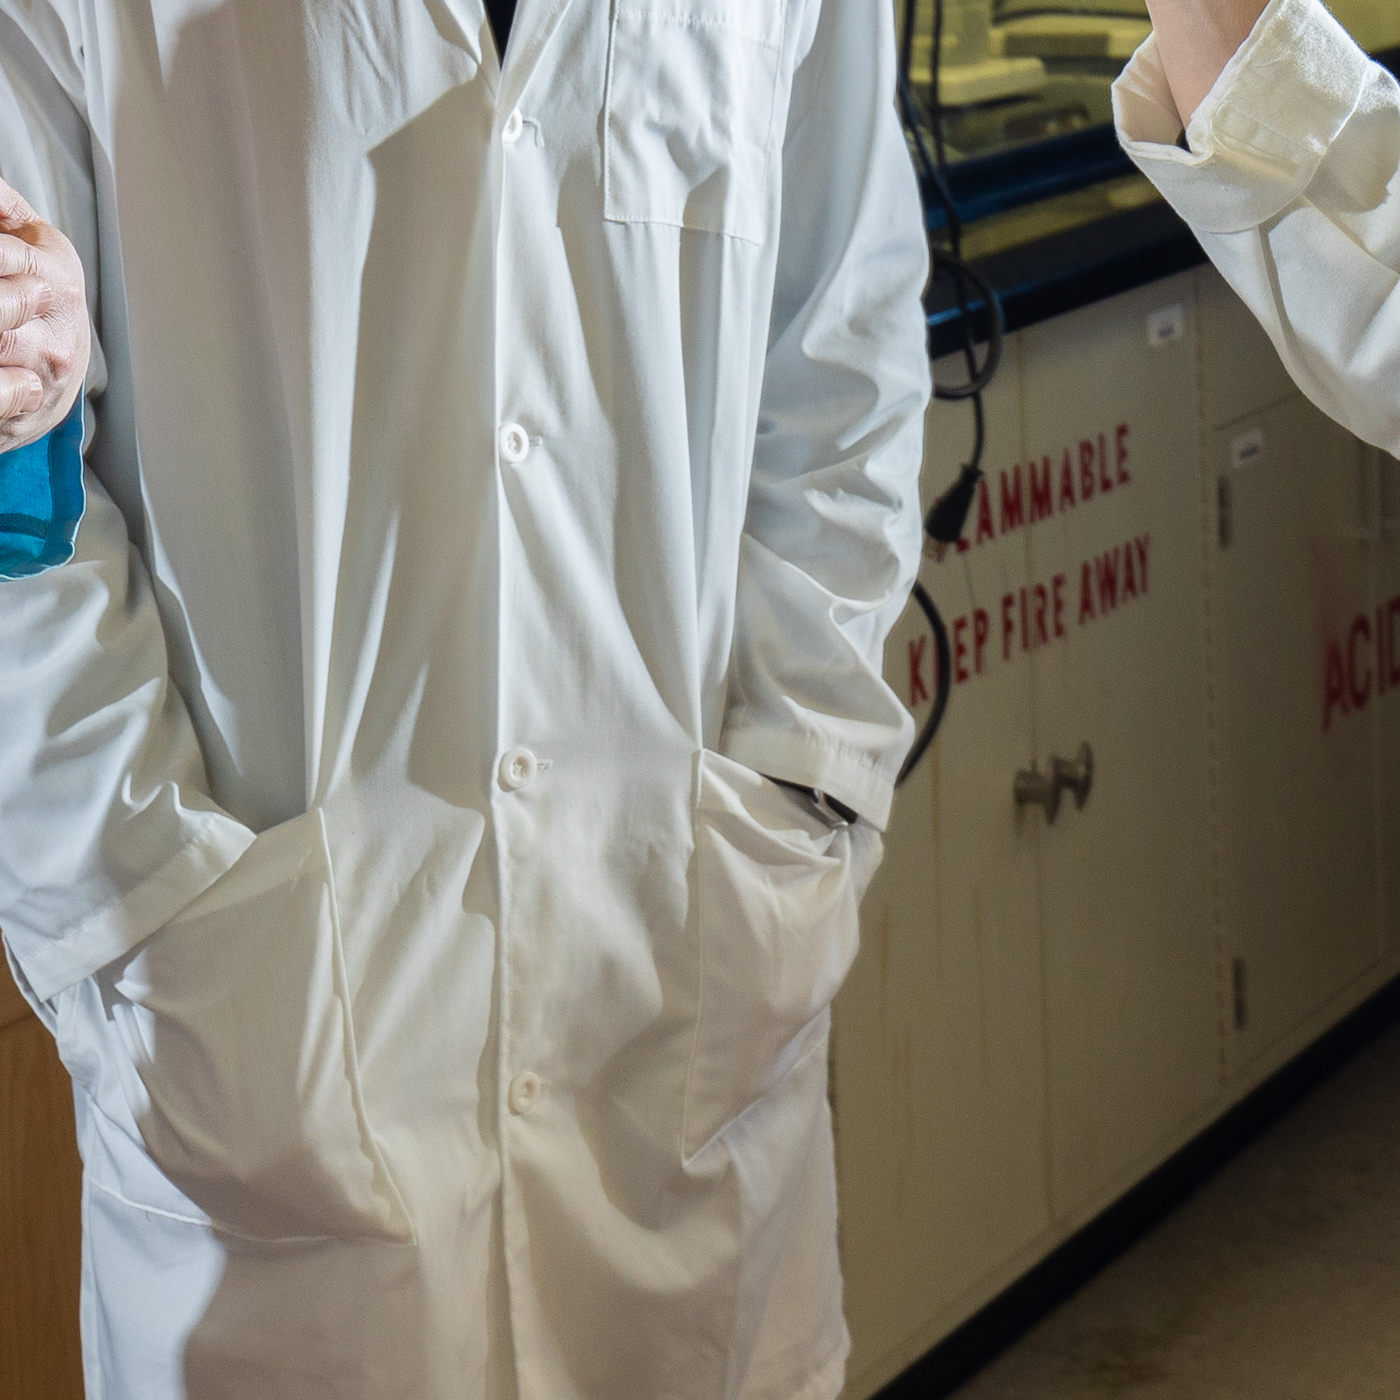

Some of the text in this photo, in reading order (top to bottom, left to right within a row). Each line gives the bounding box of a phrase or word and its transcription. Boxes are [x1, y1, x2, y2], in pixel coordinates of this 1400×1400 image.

[930, 422, 1131, 564] AMMABLE
[1001, 571, 1068, 662] FIRE
[1078, 532, 1151, 627] AWAY
